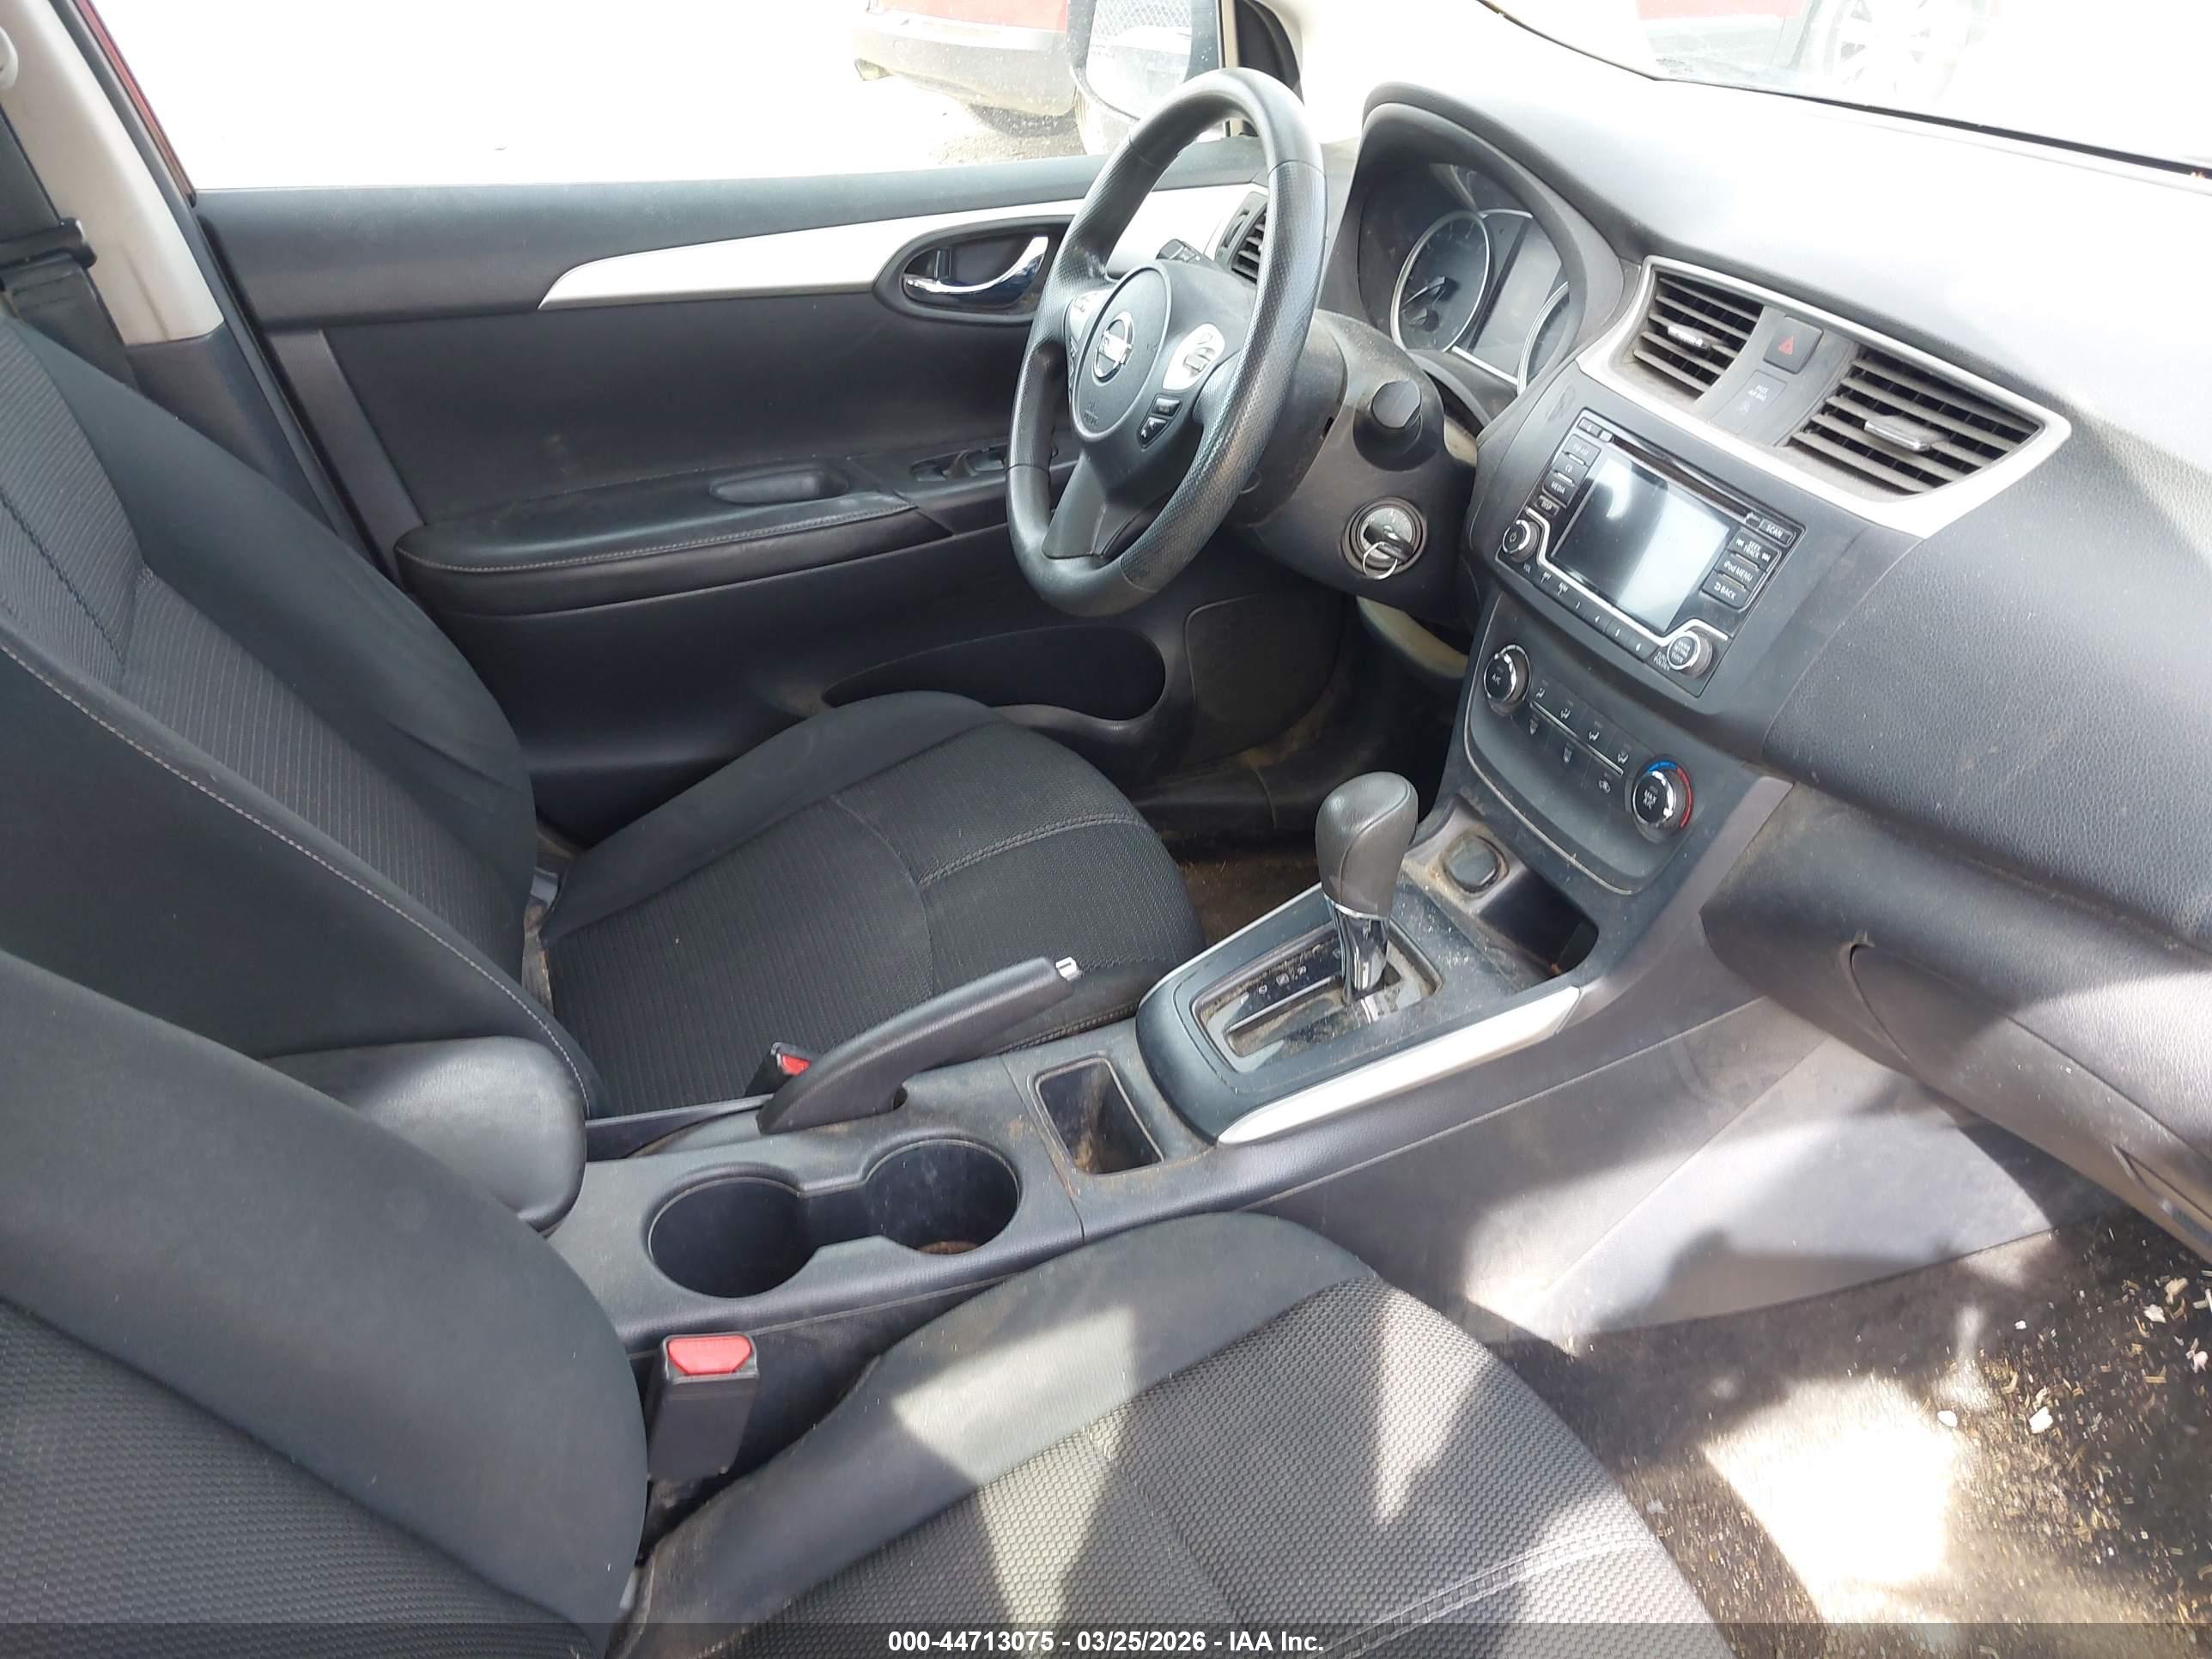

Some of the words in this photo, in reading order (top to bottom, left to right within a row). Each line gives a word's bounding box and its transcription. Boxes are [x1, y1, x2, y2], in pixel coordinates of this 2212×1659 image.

[1551, 481, 1565, 495] MEDIA
[1765, 524, 1784, 538] SCAN
[1743, 544, 1759, 558] TRACK
[1749, 541, 1761, 551] SEEK
[1723, 561, 1735, 572] iPod
[1735, 566, 1753, 582] MENU
[1720, 585, 1736, 600] BACK
[1492, 673, 1501, 685] A/C
[1644, 790, 1657, 804] MAX
